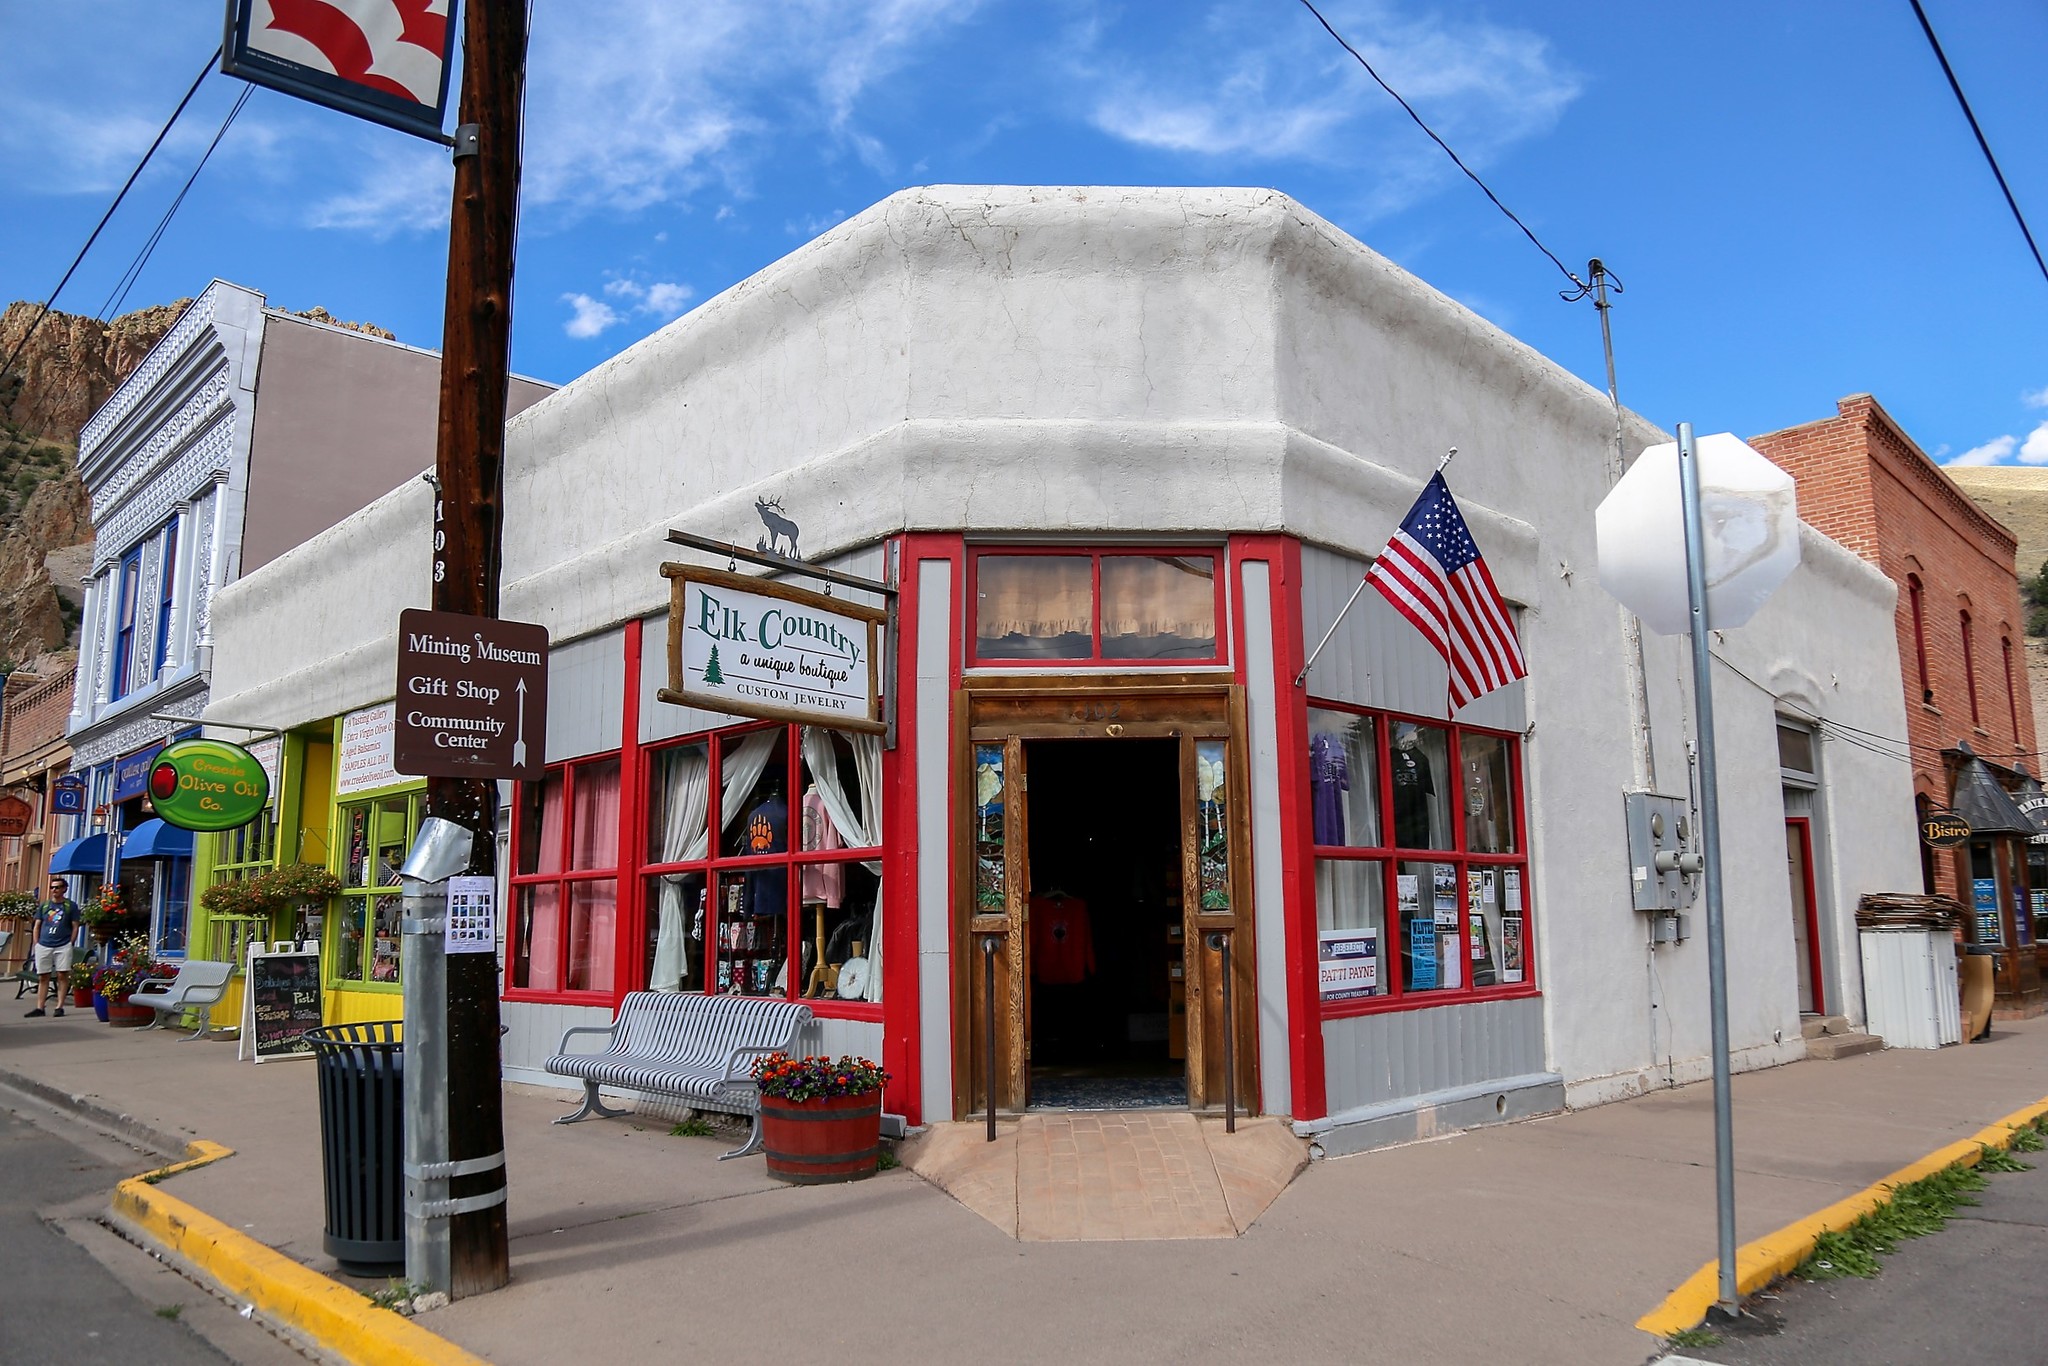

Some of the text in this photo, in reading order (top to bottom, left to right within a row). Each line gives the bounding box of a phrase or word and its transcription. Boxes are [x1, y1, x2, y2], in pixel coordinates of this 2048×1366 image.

[698, 589, 861, 670] Elk Country
[408, 633, 541, 665] Mining Museum
[740, 653, 849, 689] a unique boutique
[408, 676, 500, 705] Gift Shop
[737, 683, 847, 710] CUSTOM JEWELRY
[352, 714, 369, 727] Tasting
[370, 709, 388, 722] Gallery
[407, 711, 505, 737] Community
[346, 731, 358, 742] Extra
[360, 727, 374, 739] Virgin
[375, 725, 387, 735] Olive
[434, 731, 488, 750] Center
[345, 741, 381, 759] Aged Balsamics
[193, 759, 245, 777] Creede
[344, 753, 390, 772] SAMPLES ALL DAY
[179, 774, 259, 797] Olive Oil
[340, 769, 395, 787] www.creedeoliveoil.com
[200, 797, 224, 811] Co.
[1923, 822, 1969, 840] Bistro
[1335, 942, 1363, 953] RE-ELECT
[1321, 965, 1375, 983] PATTI PAYNE
[1335, 991, 1350, 1000] COUNTY
